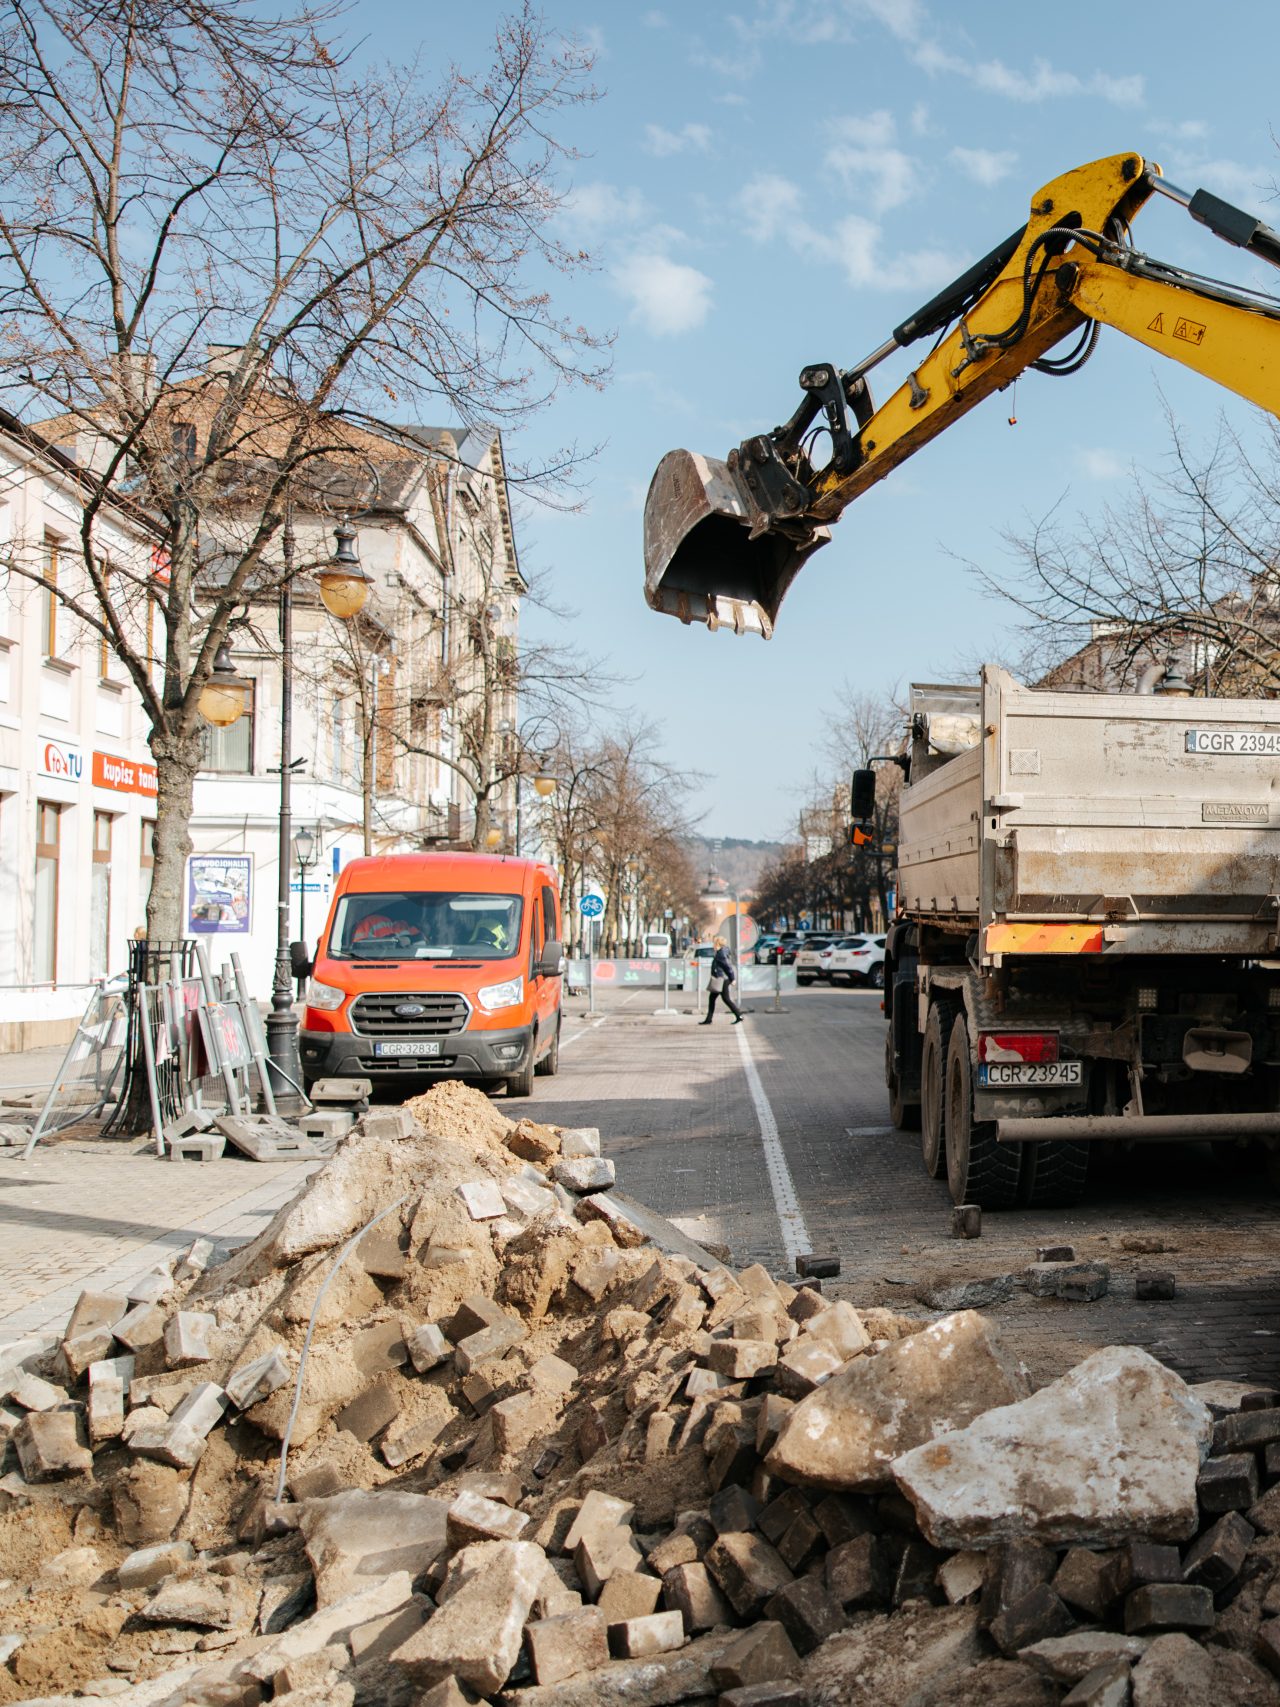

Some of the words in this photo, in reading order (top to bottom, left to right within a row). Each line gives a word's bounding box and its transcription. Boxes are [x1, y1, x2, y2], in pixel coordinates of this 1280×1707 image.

[1198, 733, 1234, 751] CGR
[103, 757, 134, 787] kupisz
[1206, 804, 1268, 816] METANOVA
[382, 1044, 402, 1055] CGR
[406, 1044, 438, 1054] 32834
[988, 1065, 1022, 1083] CGR
[1027, 1064, 1080, 1082] 23945
